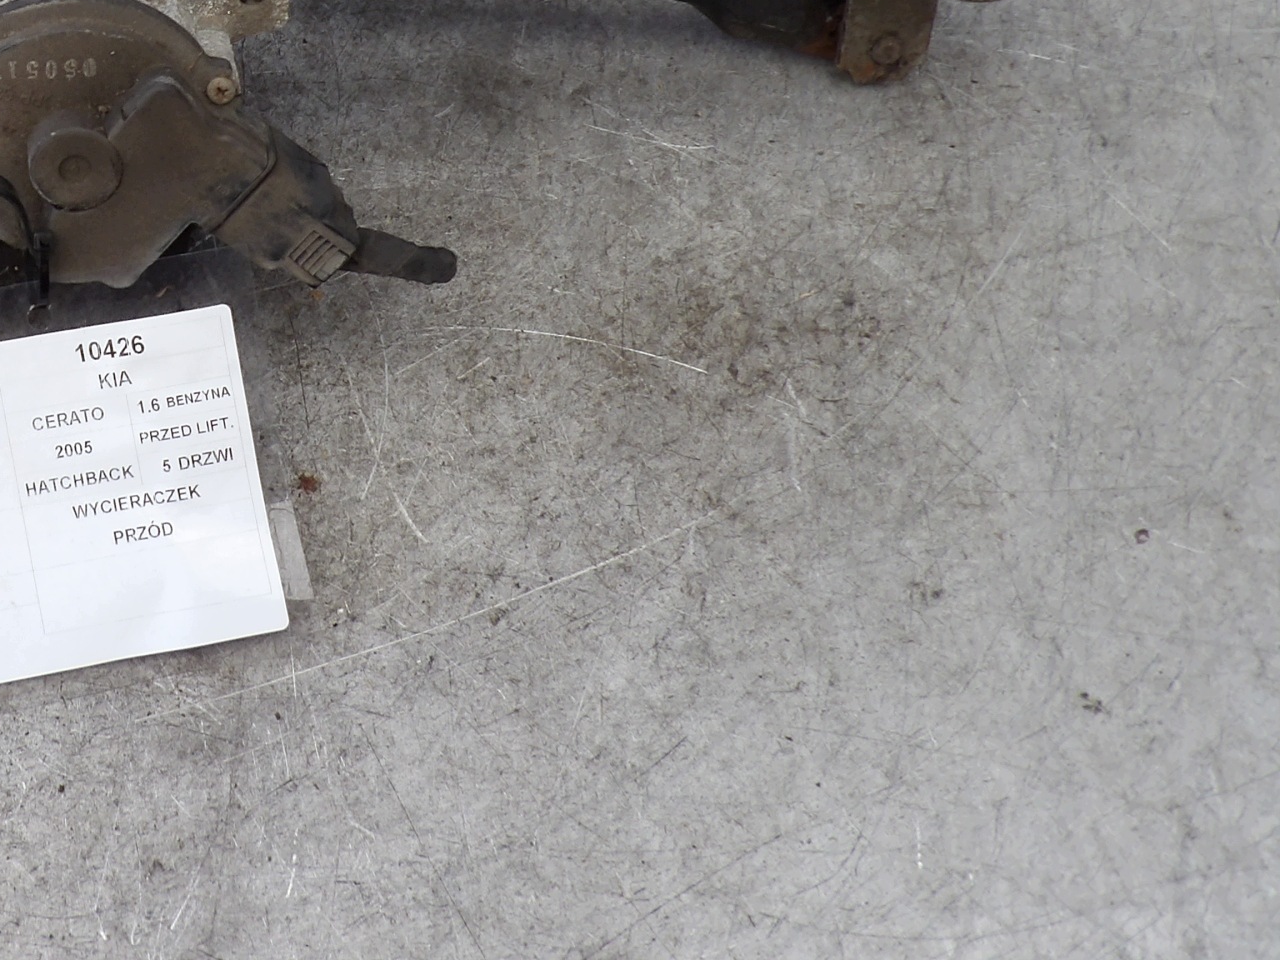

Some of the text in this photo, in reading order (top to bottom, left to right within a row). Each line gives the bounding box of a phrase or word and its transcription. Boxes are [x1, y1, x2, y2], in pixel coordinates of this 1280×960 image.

[74, 335, 146, 363] 10426
[98, 370, 133, 390] KIA
[136, 386, 231, 415] 1.6 BENZYNA
[32, 406, 105, 431] CERATO
[139, 416, 235, 445] PRZED LIFT.
[55, 440, 94, 459] 2005
[162, 447, 234, 473] 5 DRZWI
[25, 465, 135, 497] HATCHBACK
[72, 485, 202, 519] WYCIERACZEK
[113, 521, 174, 545] PRZÓD
